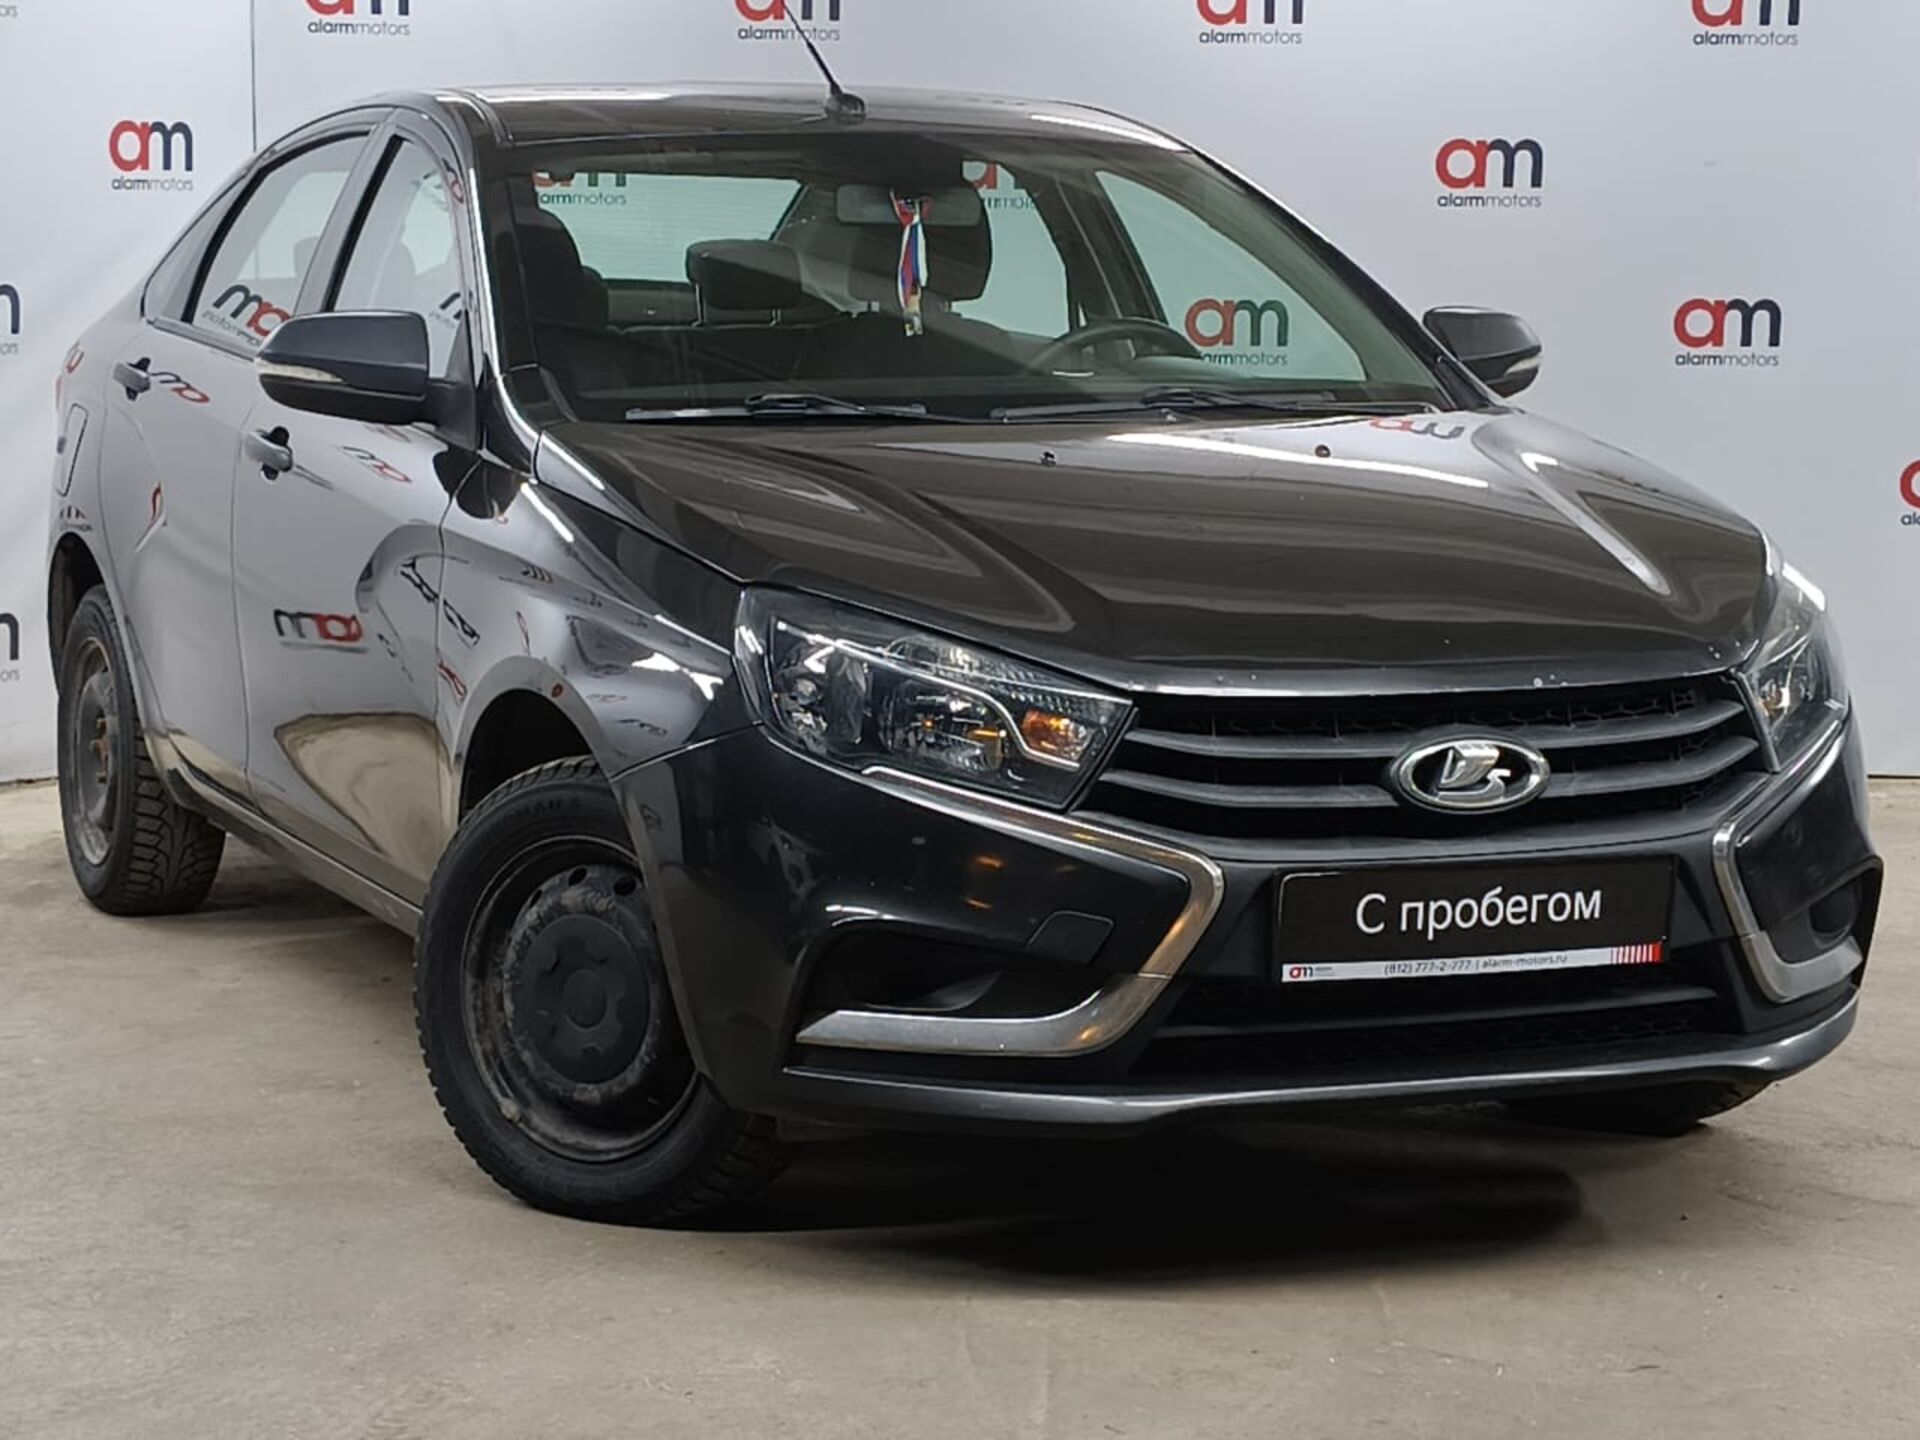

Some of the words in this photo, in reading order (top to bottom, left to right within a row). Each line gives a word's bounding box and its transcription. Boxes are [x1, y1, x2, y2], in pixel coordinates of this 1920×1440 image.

[307, 19, 411, 36] alarmmotors
[1199, 29, 1302, 45] alarmmotors
[1693, 30, 1799, 46] alarmmotors
[109, 119, 193, 172] am
[1435, 138, 1543, 189] am
[111, 176, 194, 191] alarmmotors
[540, 192, 627, 205] armmotors
[1437, 192, 1542, 208] alarmmotors
[1185, 298, 1289, 347] am
[1673, 298, 1782, 348] am
[1675, 351, 1780, 367] alarmmotors
[1356, 893, 1387, 933] С
[1400, 885, 1602, 941] пробегом
